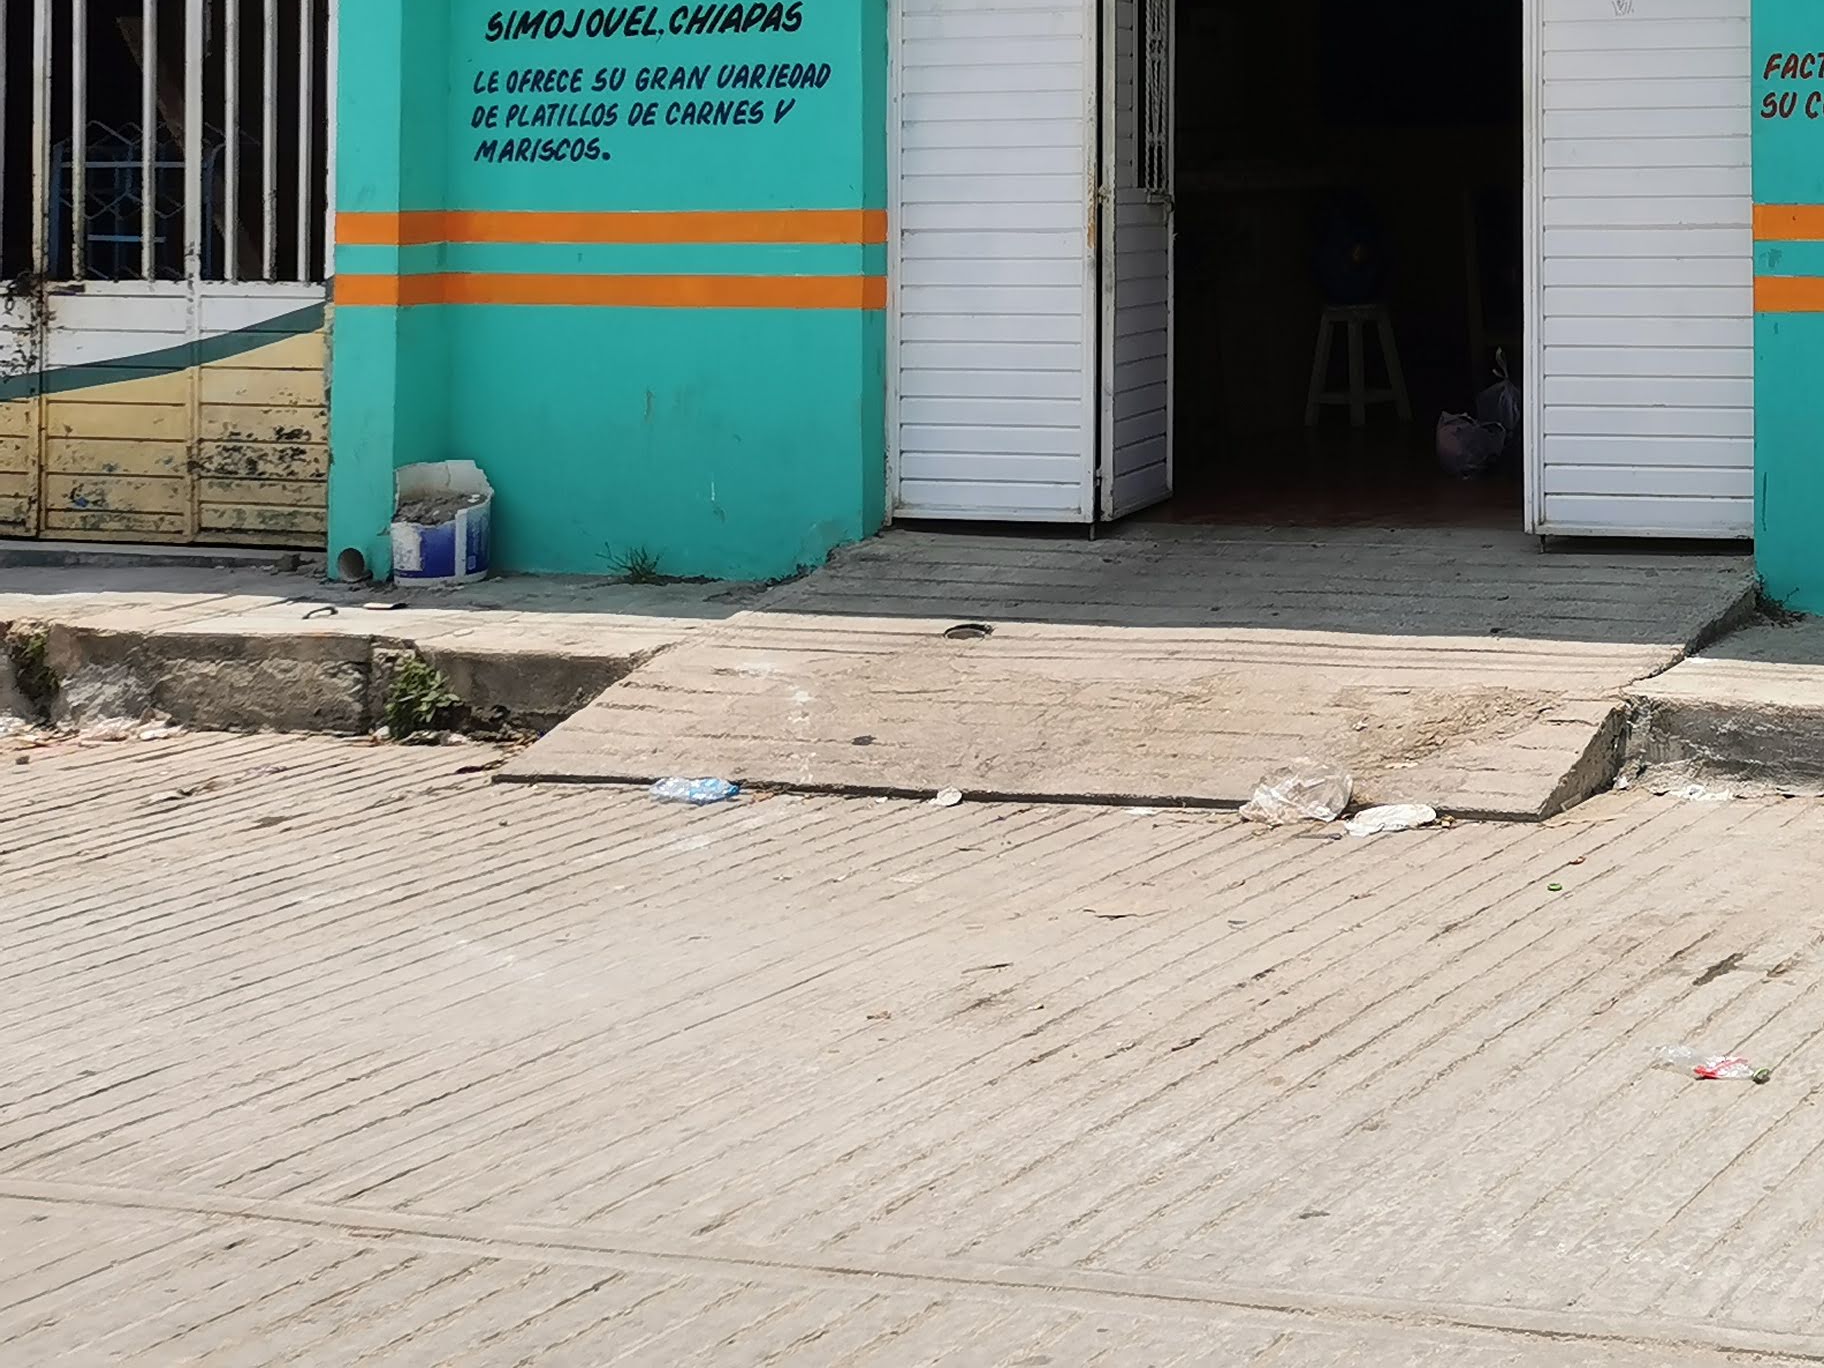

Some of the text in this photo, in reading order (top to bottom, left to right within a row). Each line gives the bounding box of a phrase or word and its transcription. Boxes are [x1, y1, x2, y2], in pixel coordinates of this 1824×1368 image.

[473, 70, 500, 95] LE
[505, 67, 584, 94] OFRECE
[590, 67, 627, 92] SU
[635, 64, 712, 92] GRAN
[470, 104, 499, 129] DE
[505, 102, 619, 129] PLATILLOS
[627, 101, 660, 127] DE
[665, 100, 765, 126] CARNES
[1760, 91, 1798, 119] SU
[473, 137, 611, 164] MARISCOS.
